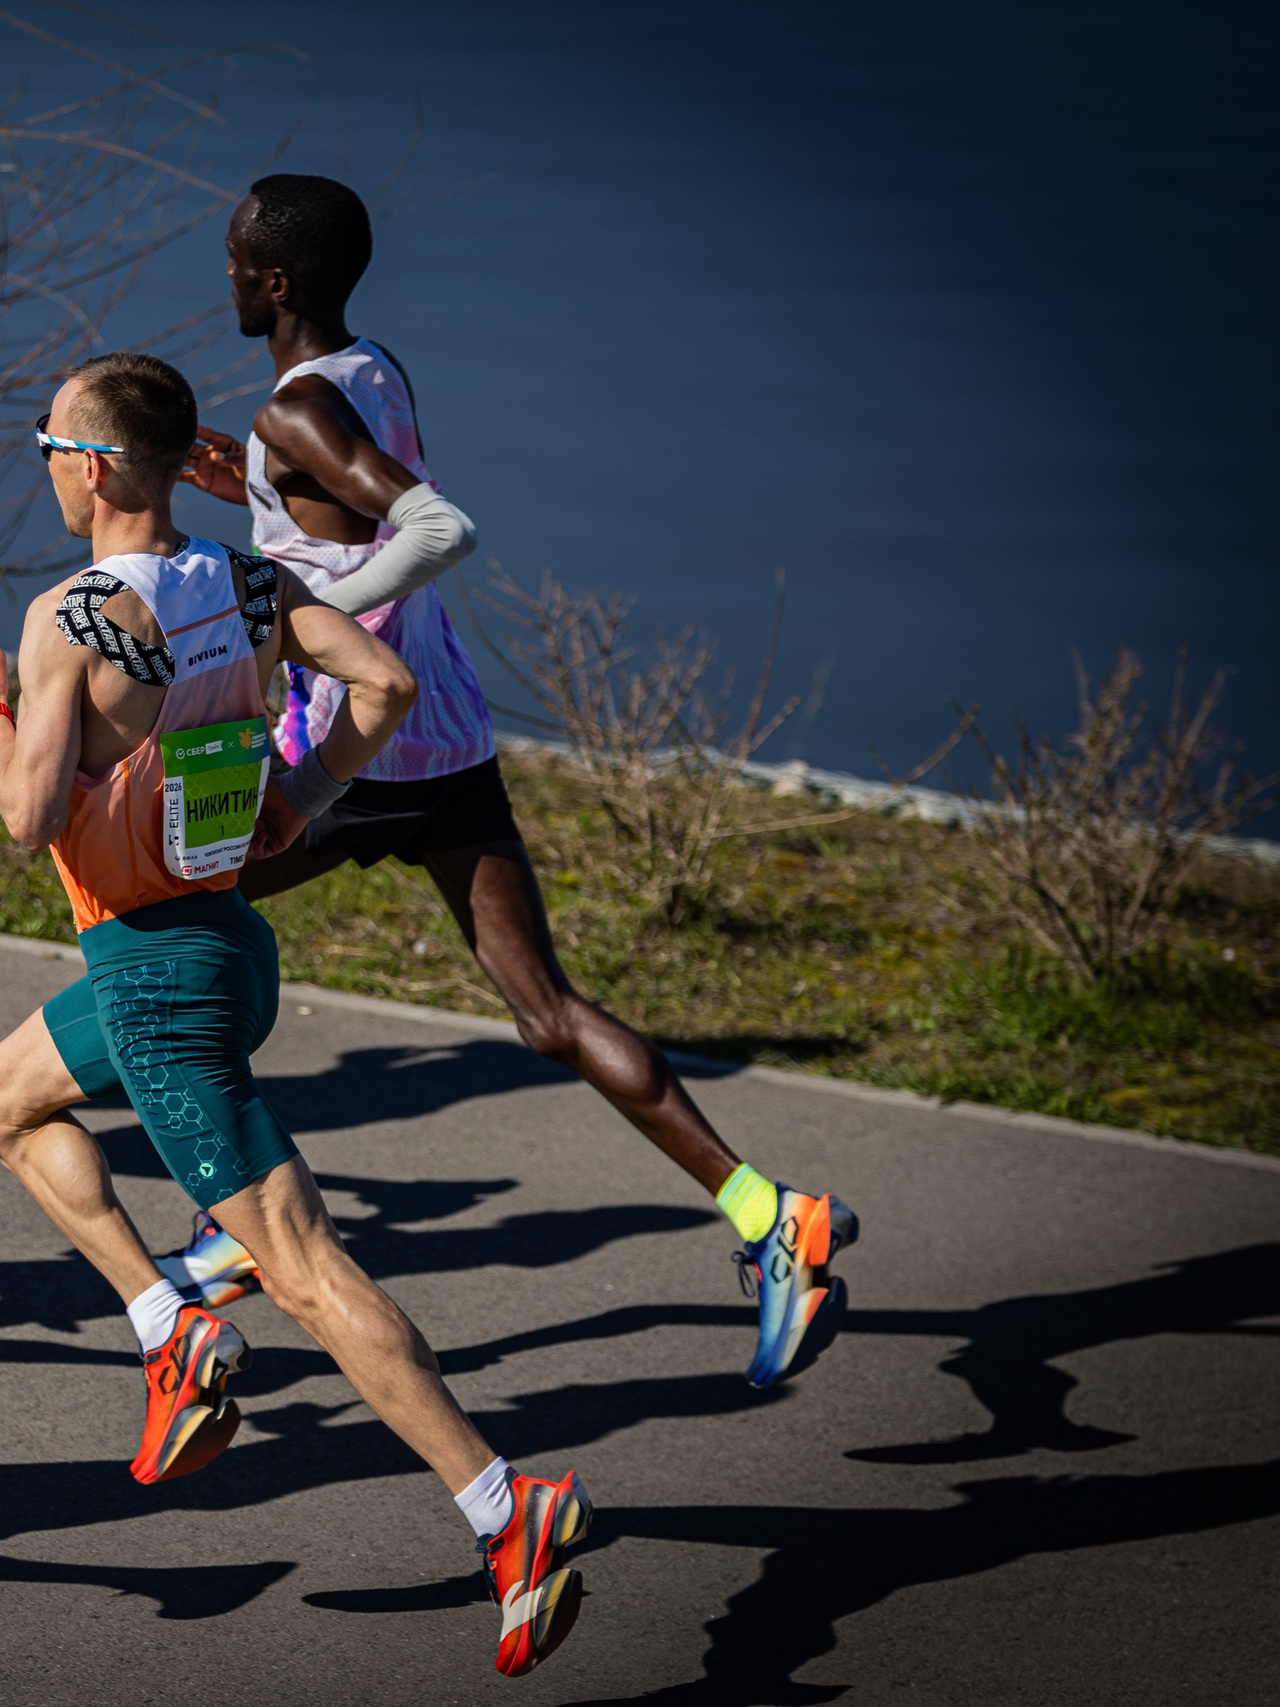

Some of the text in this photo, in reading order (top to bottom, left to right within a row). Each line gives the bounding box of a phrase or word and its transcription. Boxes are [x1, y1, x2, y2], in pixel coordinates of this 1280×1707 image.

[121, 632, 150, 680] ROCKTAPE
[188, 645, 228, 667] BIVIUM
[186, 746, 205, 757] СБЕР
[164, 783, 183, 793] 2026
[169, 798, 179, 829] ELITE
[220, 826, 225, 836] 1
[194, 860, 220, 875] МАГНИТ
